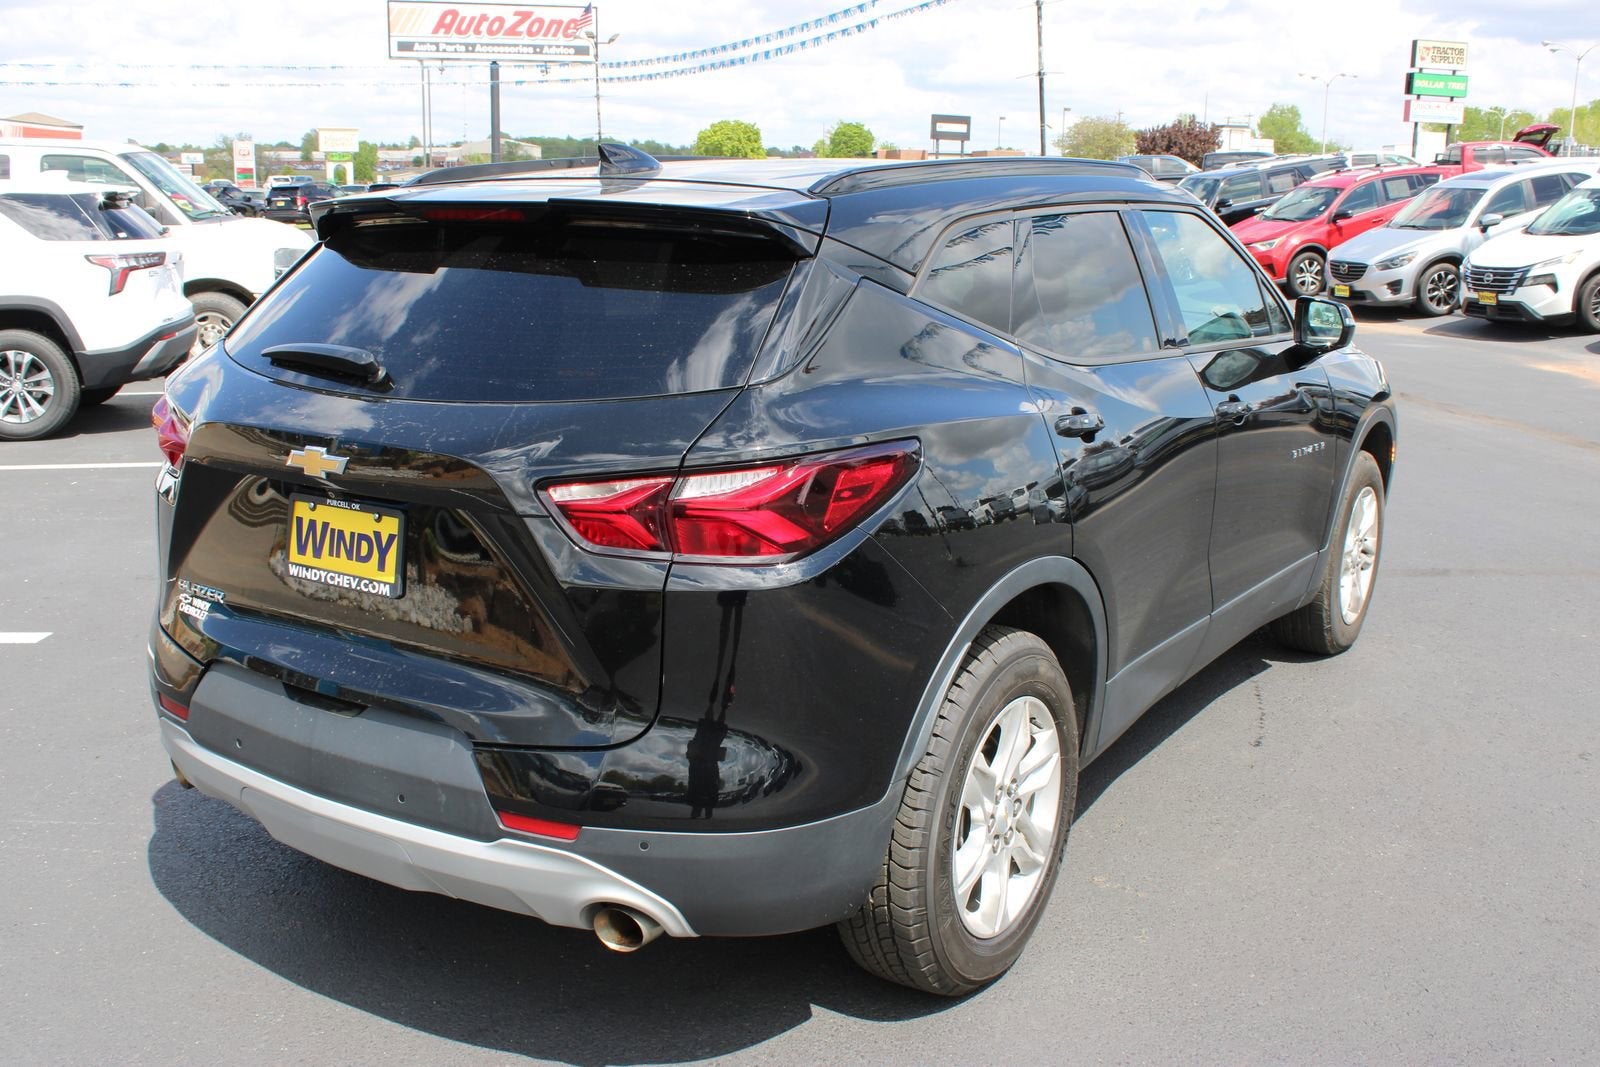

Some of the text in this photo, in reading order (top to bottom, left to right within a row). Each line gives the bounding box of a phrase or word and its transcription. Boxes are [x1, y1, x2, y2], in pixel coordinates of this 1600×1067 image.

[431, 9, 579, 39] AutoZone
[413, 43, 575, 55] Auto Parts Accessories Advice
[1431, 46, 1465, 56] TRACTOR
[1431, 55, 1456, 64] SUPPLY
[1415, 79, 1466, 91] DOLLAR TREE
[288, 563, 391, 597] WINDYCHEV.COM
[179, 578, 225, 604] BLAZER
